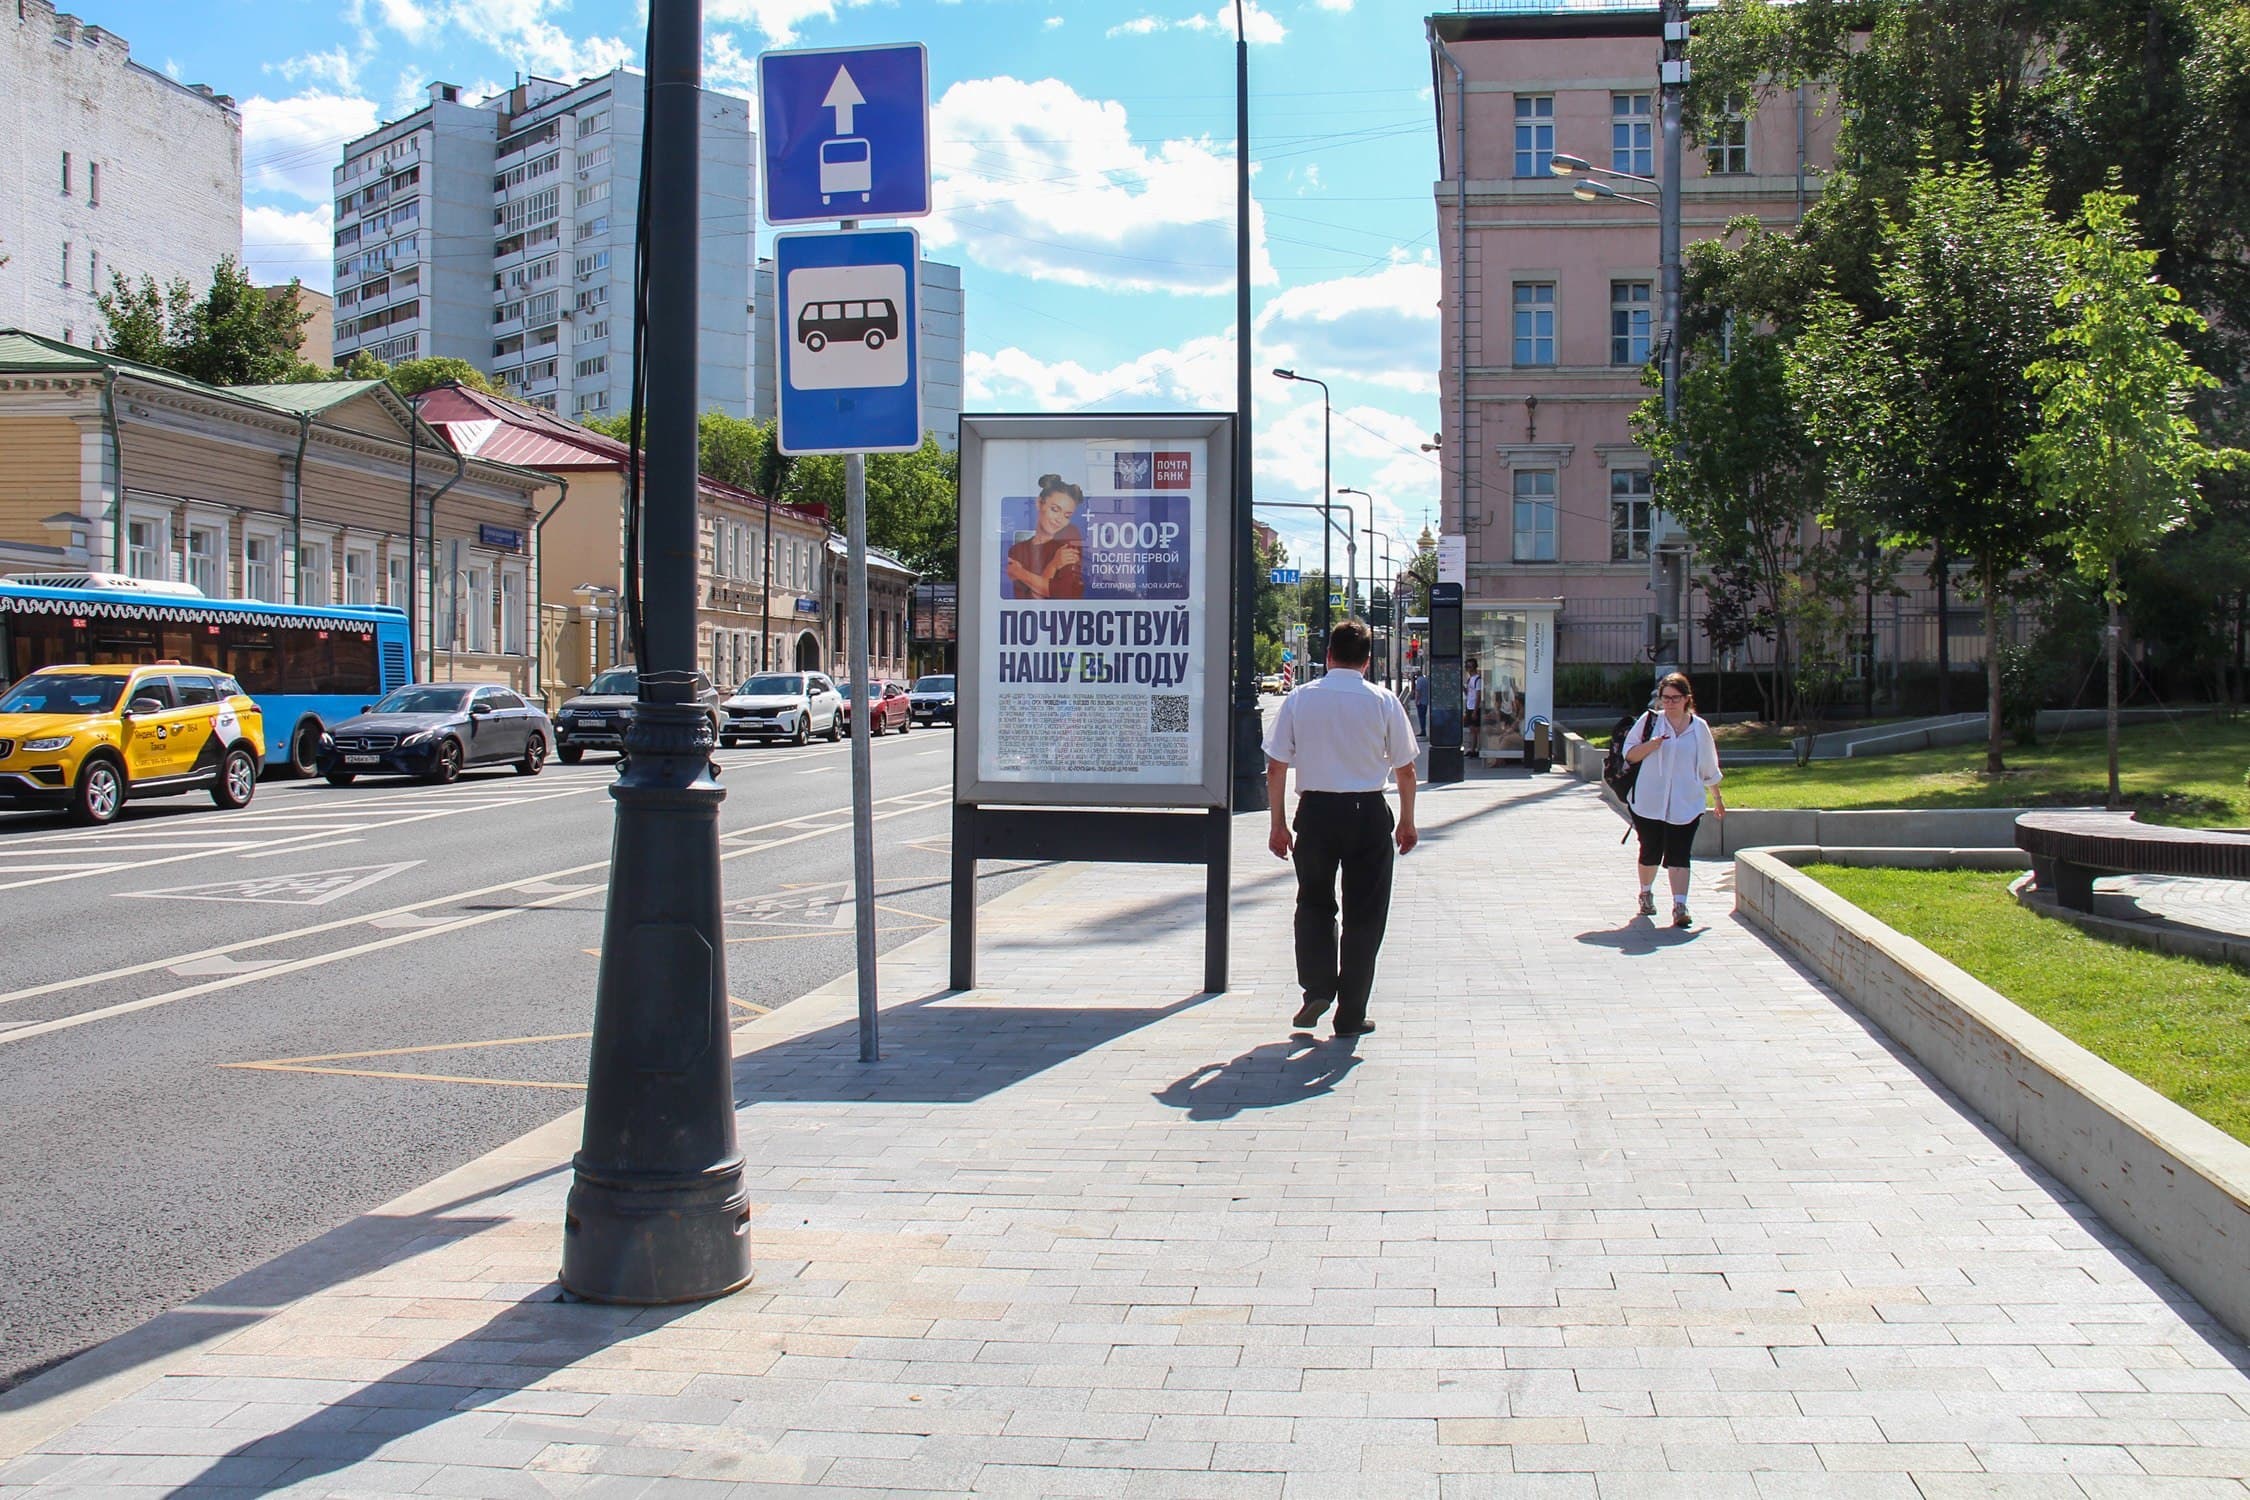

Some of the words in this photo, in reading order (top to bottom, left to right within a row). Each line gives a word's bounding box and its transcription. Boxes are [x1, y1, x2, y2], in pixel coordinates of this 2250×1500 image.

[1157, 459, 1188, 470] ПОЧТА
[1157, 470, 1184, 481] БАНК
[1091, 553, 1131, 563] ПОСЛЕ
[1133, 551, 1180, 563] ПЕРВОЙ
[1091, 564, 1145, 575] ПОКУПКИ
[999, 605, 1190, 646] ПОЧУВСТВУЙ
[999, 652, 1075, 683] НАШУ
[1079, 652, 1189, 688] ВЫГОДУ
